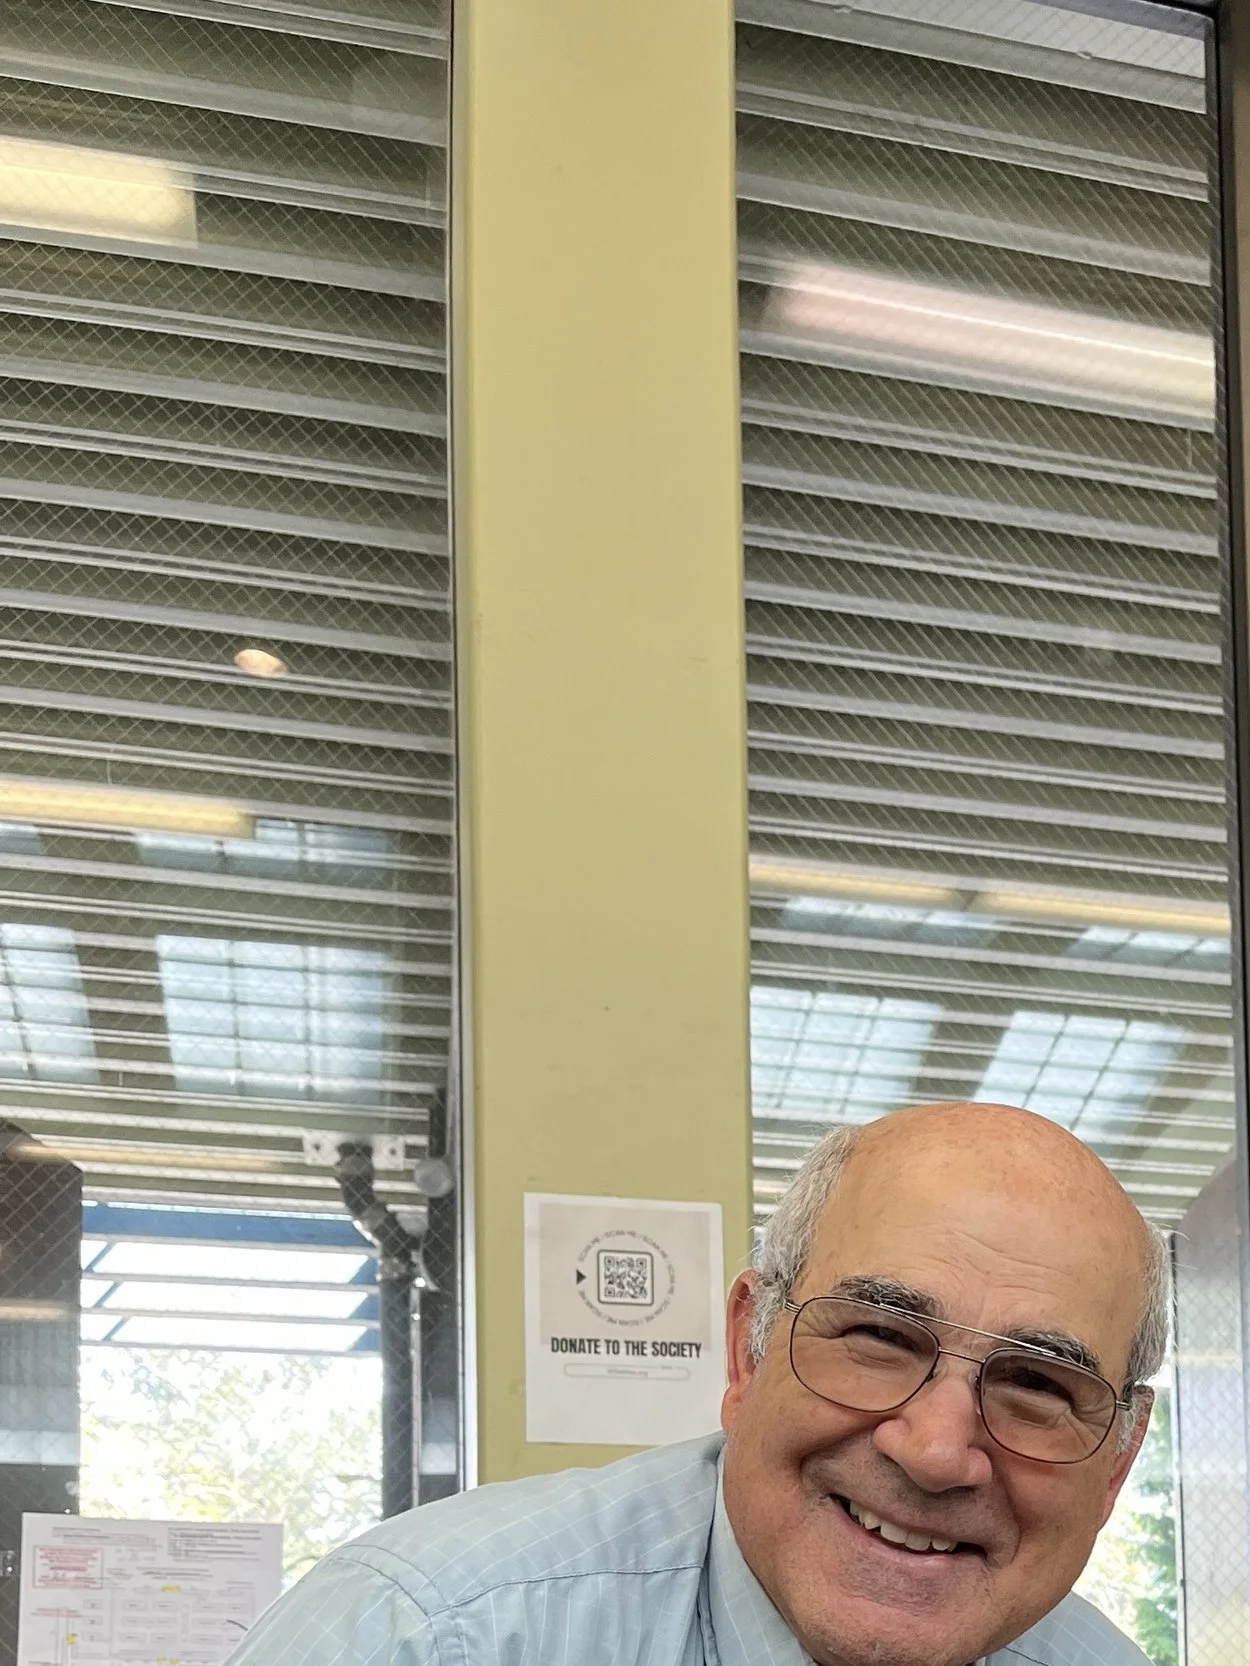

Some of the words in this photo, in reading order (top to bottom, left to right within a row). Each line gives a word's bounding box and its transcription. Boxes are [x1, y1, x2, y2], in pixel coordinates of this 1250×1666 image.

[551, 1337, 600, 1354] DONATE
[606, 1340, 620, 1355] TO
[624, 1340, 647, 1357] THE
[652, 1342, 702, 1358] SOCIETY
